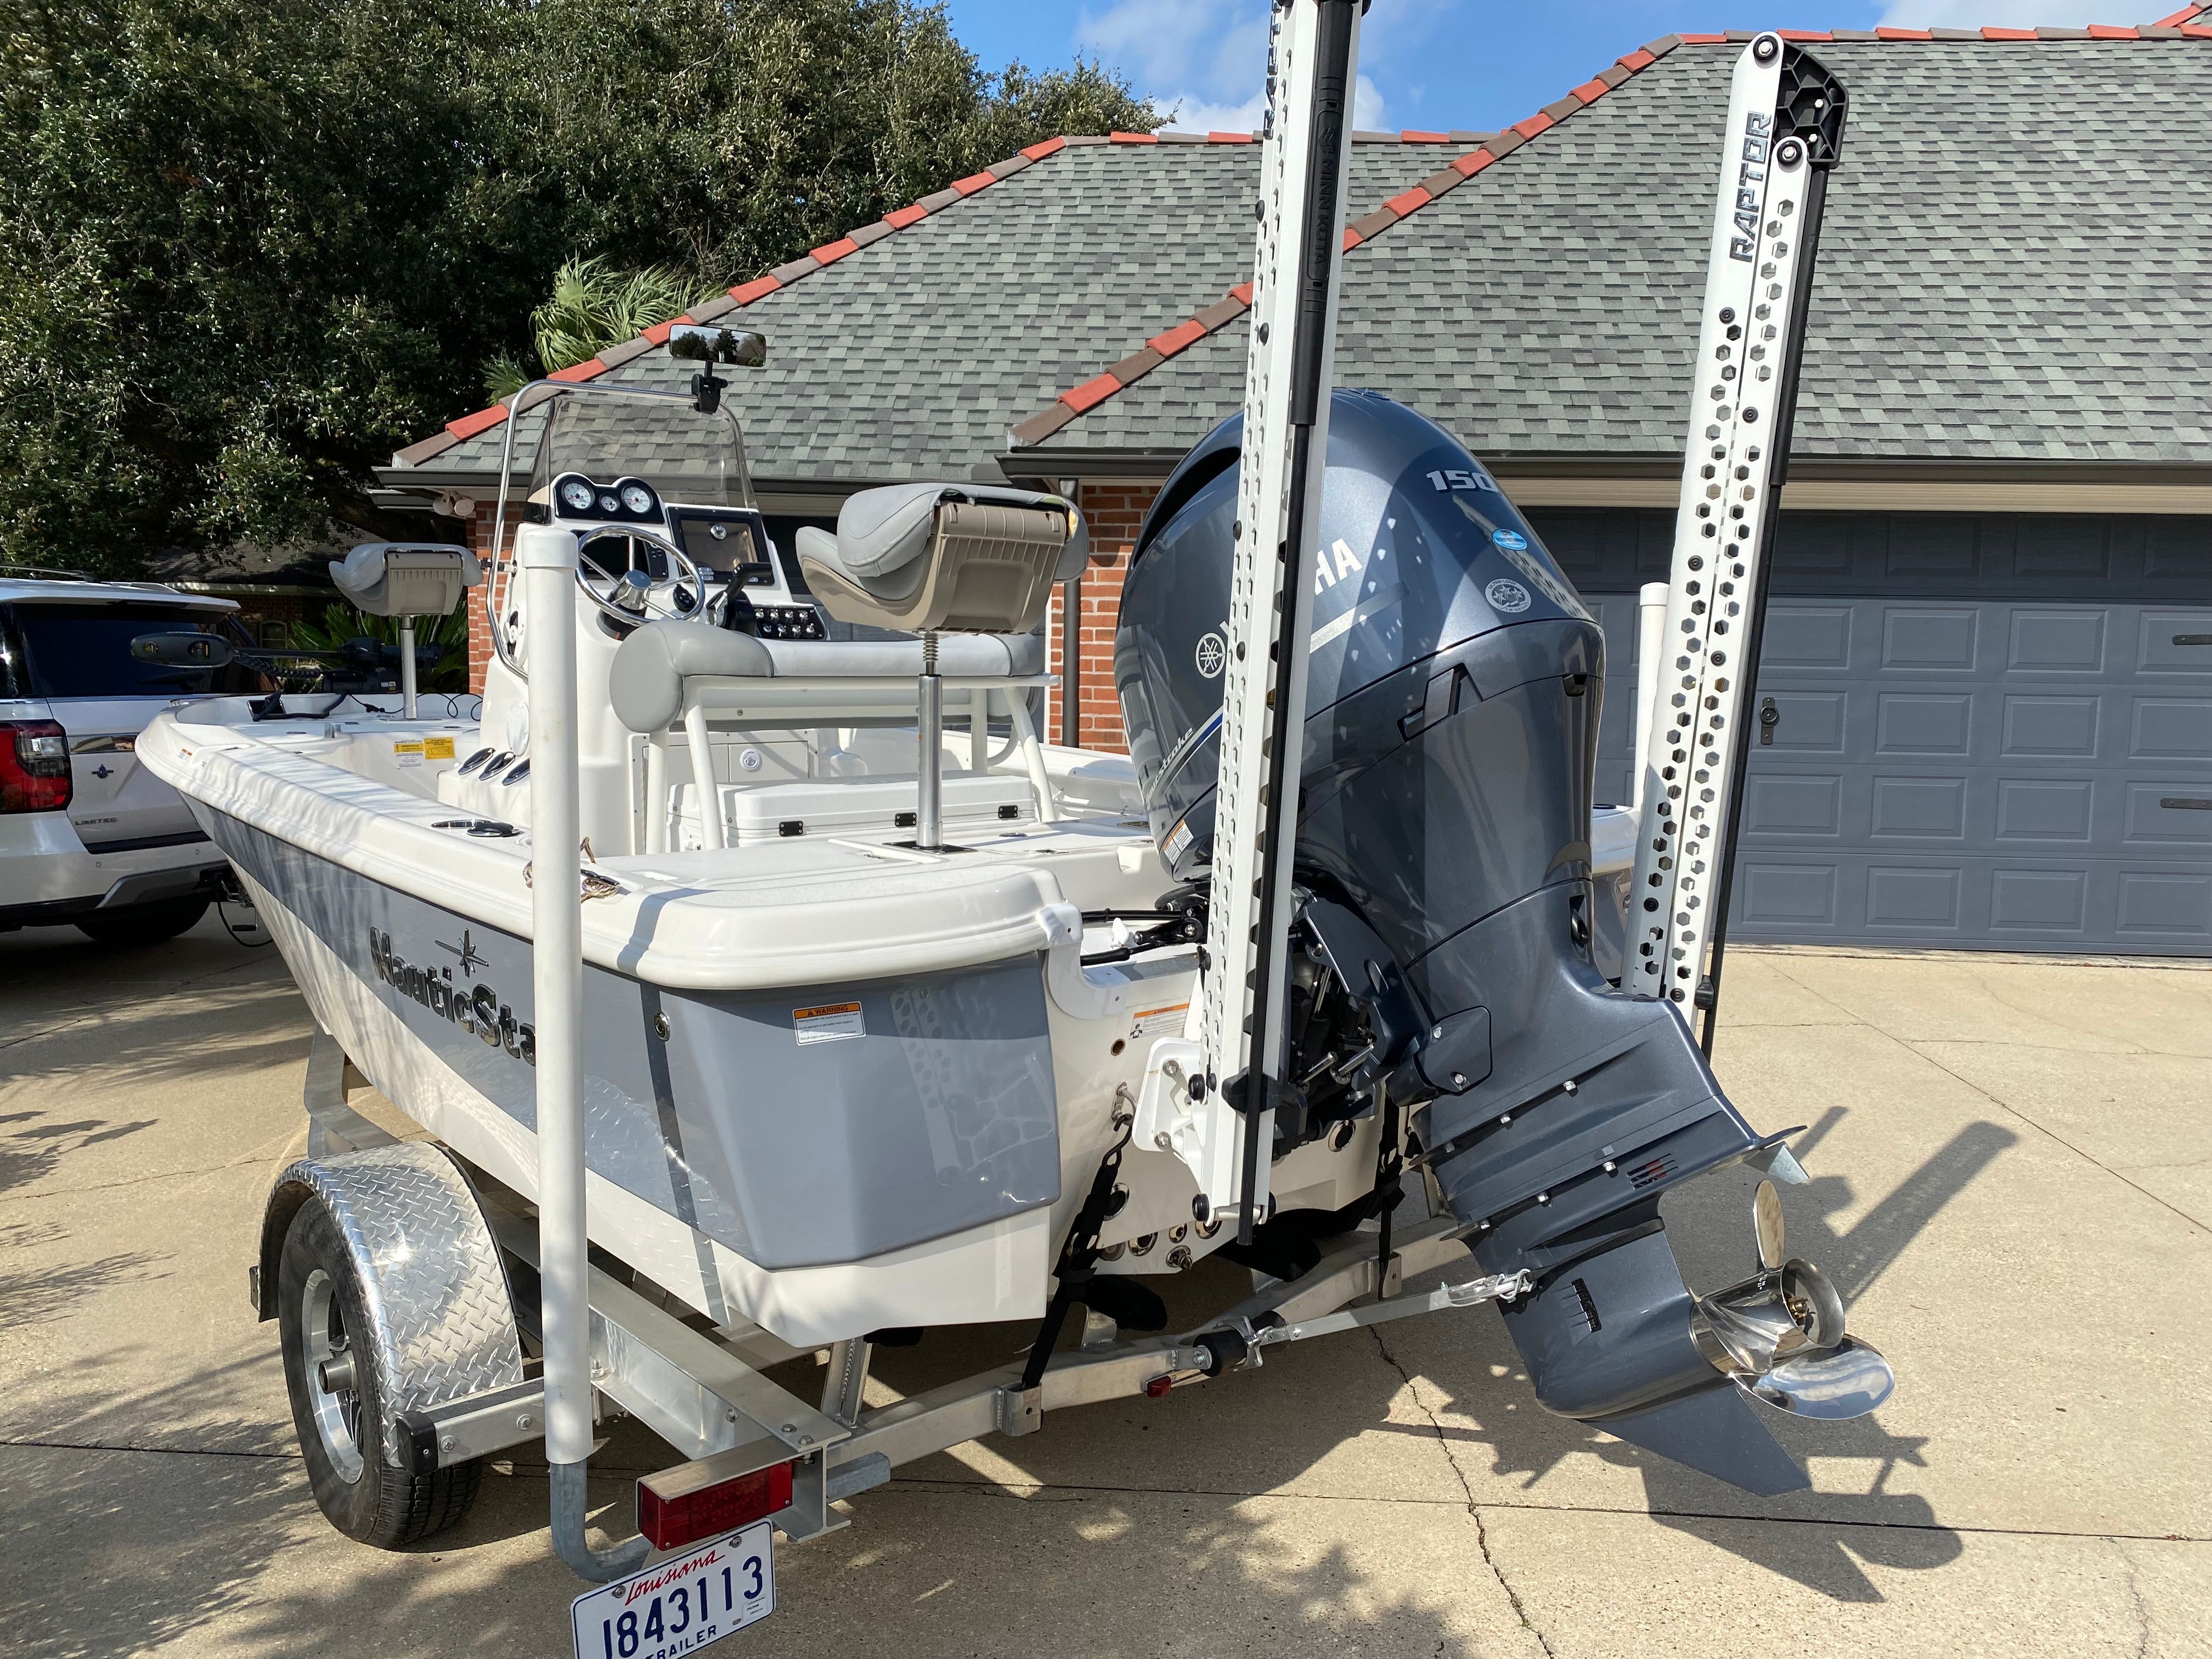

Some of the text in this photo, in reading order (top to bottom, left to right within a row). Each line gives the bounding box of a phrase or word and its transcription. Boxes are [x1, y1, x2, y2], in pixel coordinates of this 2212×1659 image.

[1263, 0, 1282, 140] RAPT
[1314, 159, 1334, 264] MINN KOTA
[1729, 110, 1771, 263] RAPTOR
[1426, 470, 1499, 493] 150
[370, 926, 536, 1067] NauticSta
[815, 1005, 849, 1015] WARNING
[625, 1549, 726, 1606] Louisiana
